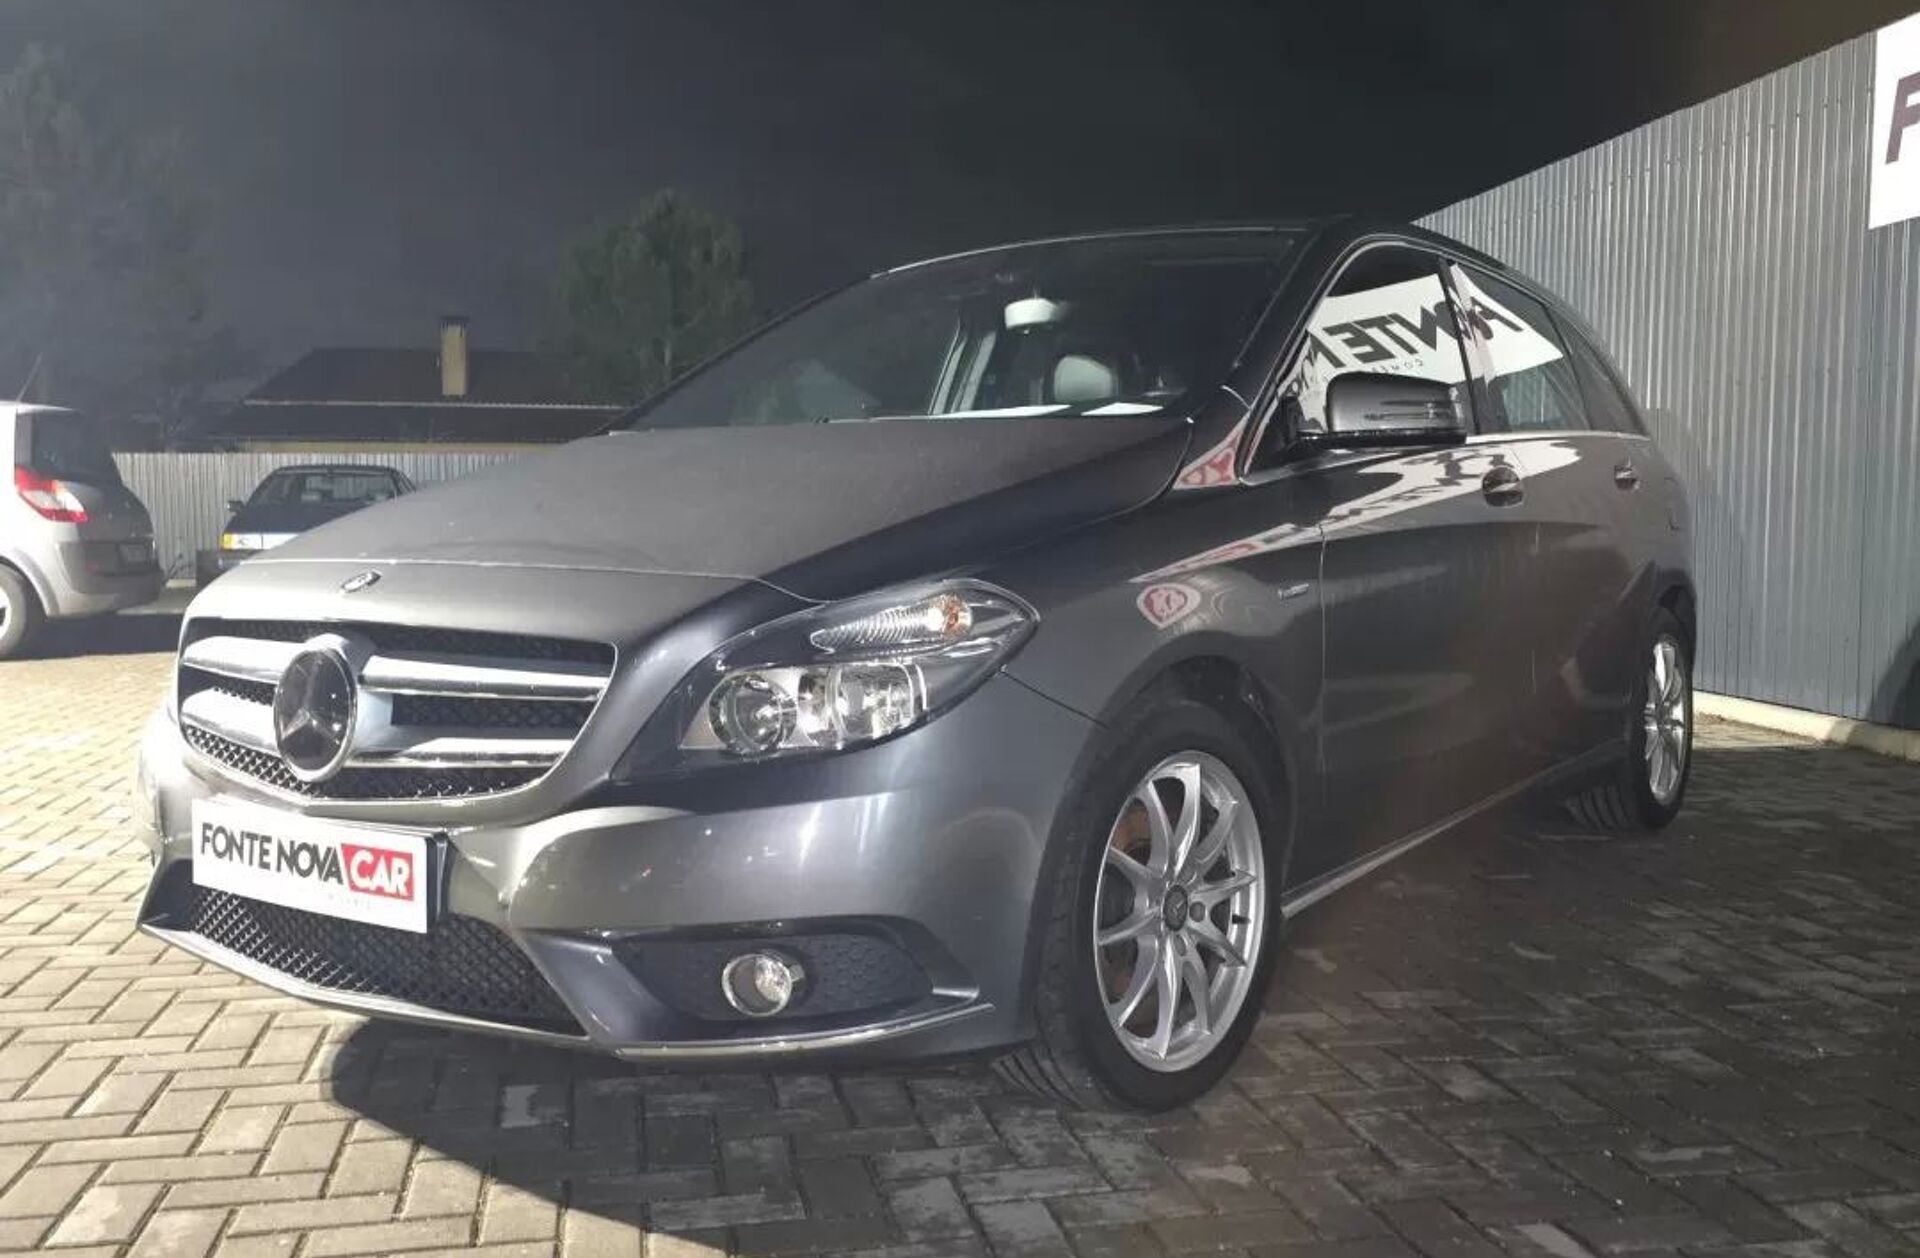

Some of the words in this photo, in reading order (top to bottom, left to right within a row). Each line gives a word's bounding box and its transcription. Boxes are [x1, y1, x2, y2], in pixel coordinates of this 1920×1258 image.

[201, 822, 272, 871] FONTE
[276, 839, 344, 885] NOVA
[350, 849, 410, 896] CAR
